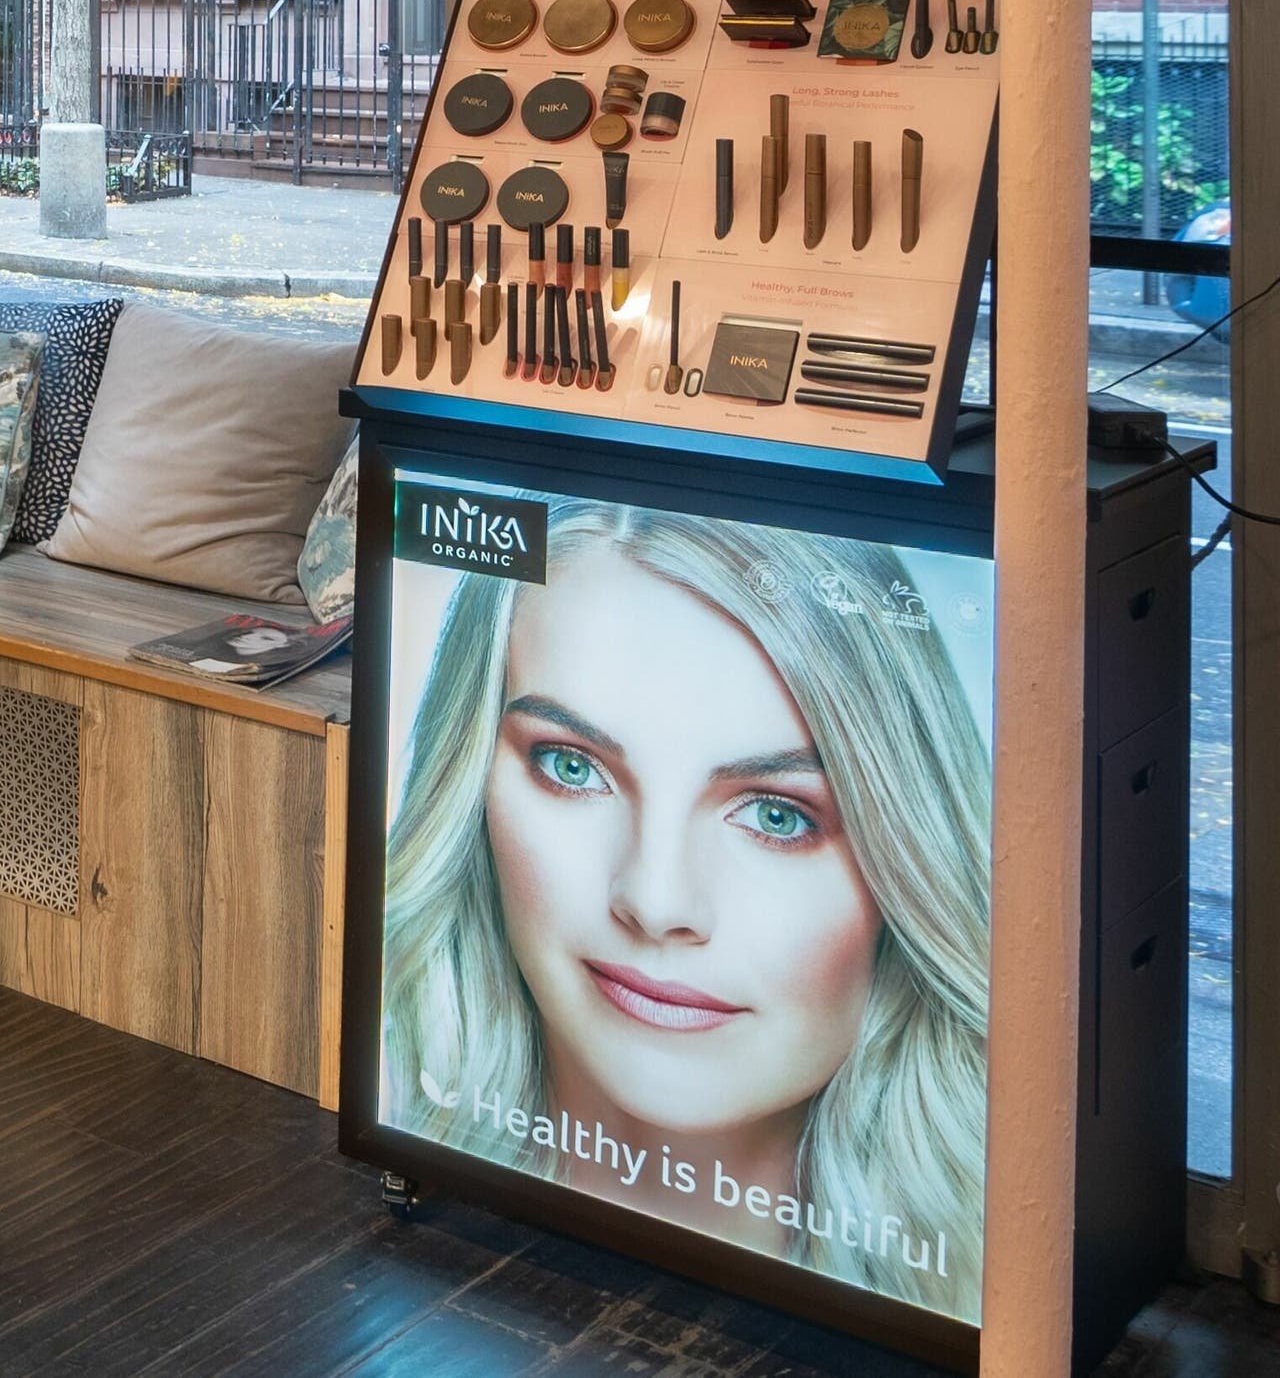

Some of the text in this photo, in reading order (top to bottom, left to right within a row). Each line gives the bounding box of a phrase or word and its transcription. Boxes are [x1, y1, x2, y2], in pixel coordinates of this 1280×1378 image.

[637, 12, 672, 22] INIKA
[843, 21, 881, 32] INIKA
[823, 86, 859, 99] Strong
[862, 88, 900, 99] Lashes
[461, 95, 488, 108] INIKA
[539, 102, 569, 114] INIKA
[437, 185, 466, 198] INIKA
[514, 190, 544, 203] INIKA
[796, 284, 817, 295] Full
[819, 286, 855, 298] Brows
[730, 354, 768, 370] INIKA
[432, 542, 514, 567] ORGANIC
[899, 612, 930, 624] TESTED
[472, 1084, 949, 1278] Healthy is beautiful
